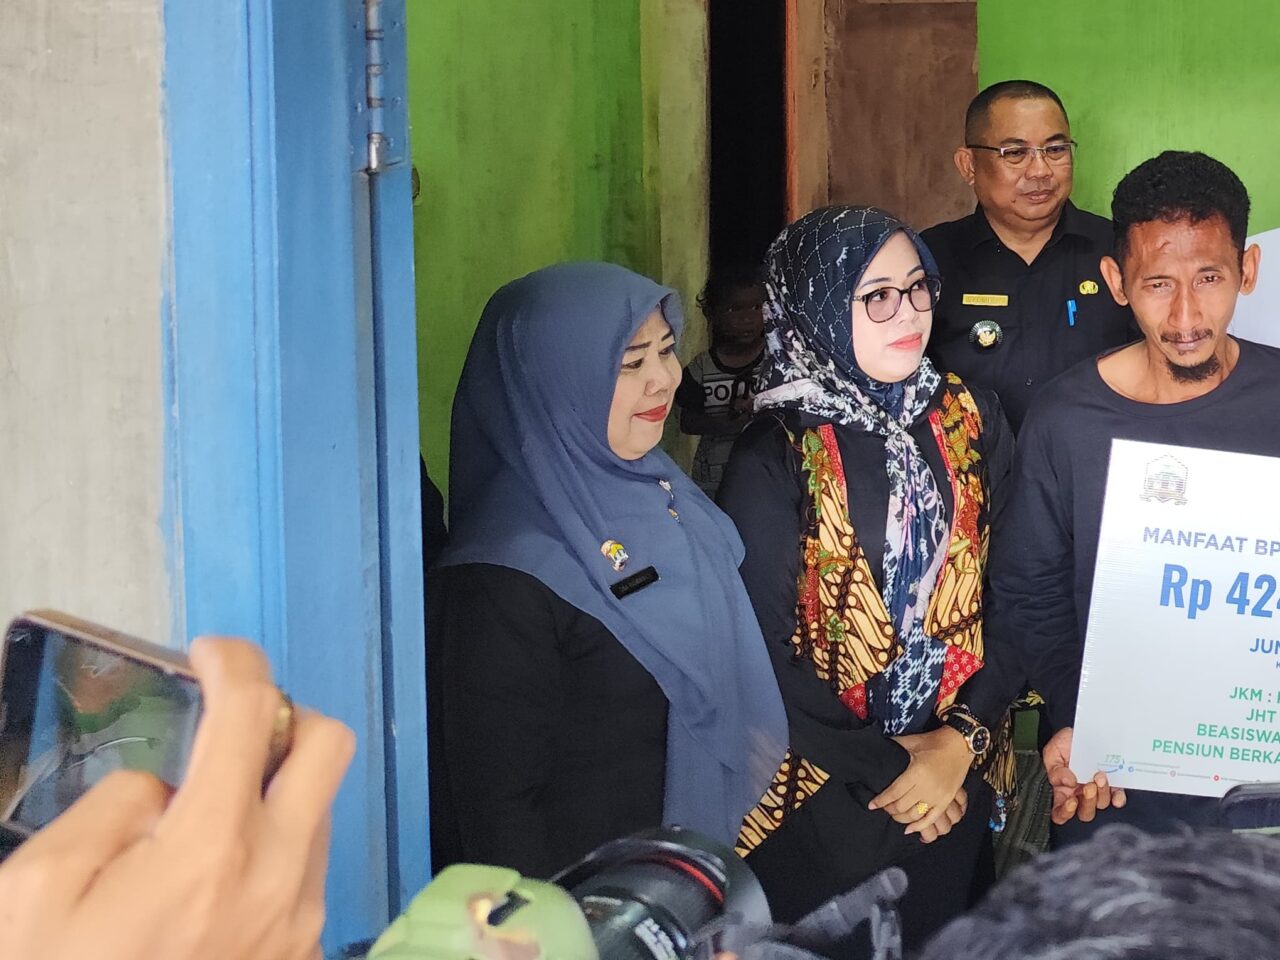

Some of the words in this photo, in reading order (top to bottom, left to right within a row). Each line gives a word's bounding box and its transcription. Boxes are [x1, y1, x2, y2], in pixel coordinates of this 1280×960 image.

[1143, 526, 1248, 553] MANFAAT
[1159, 563, 1212, 620] Rp
[1229, 686, 1262, 702] JKM
[1246, 708, 1277, 724] JHT
[1152, 739, 1224, 759] PENSIUN
